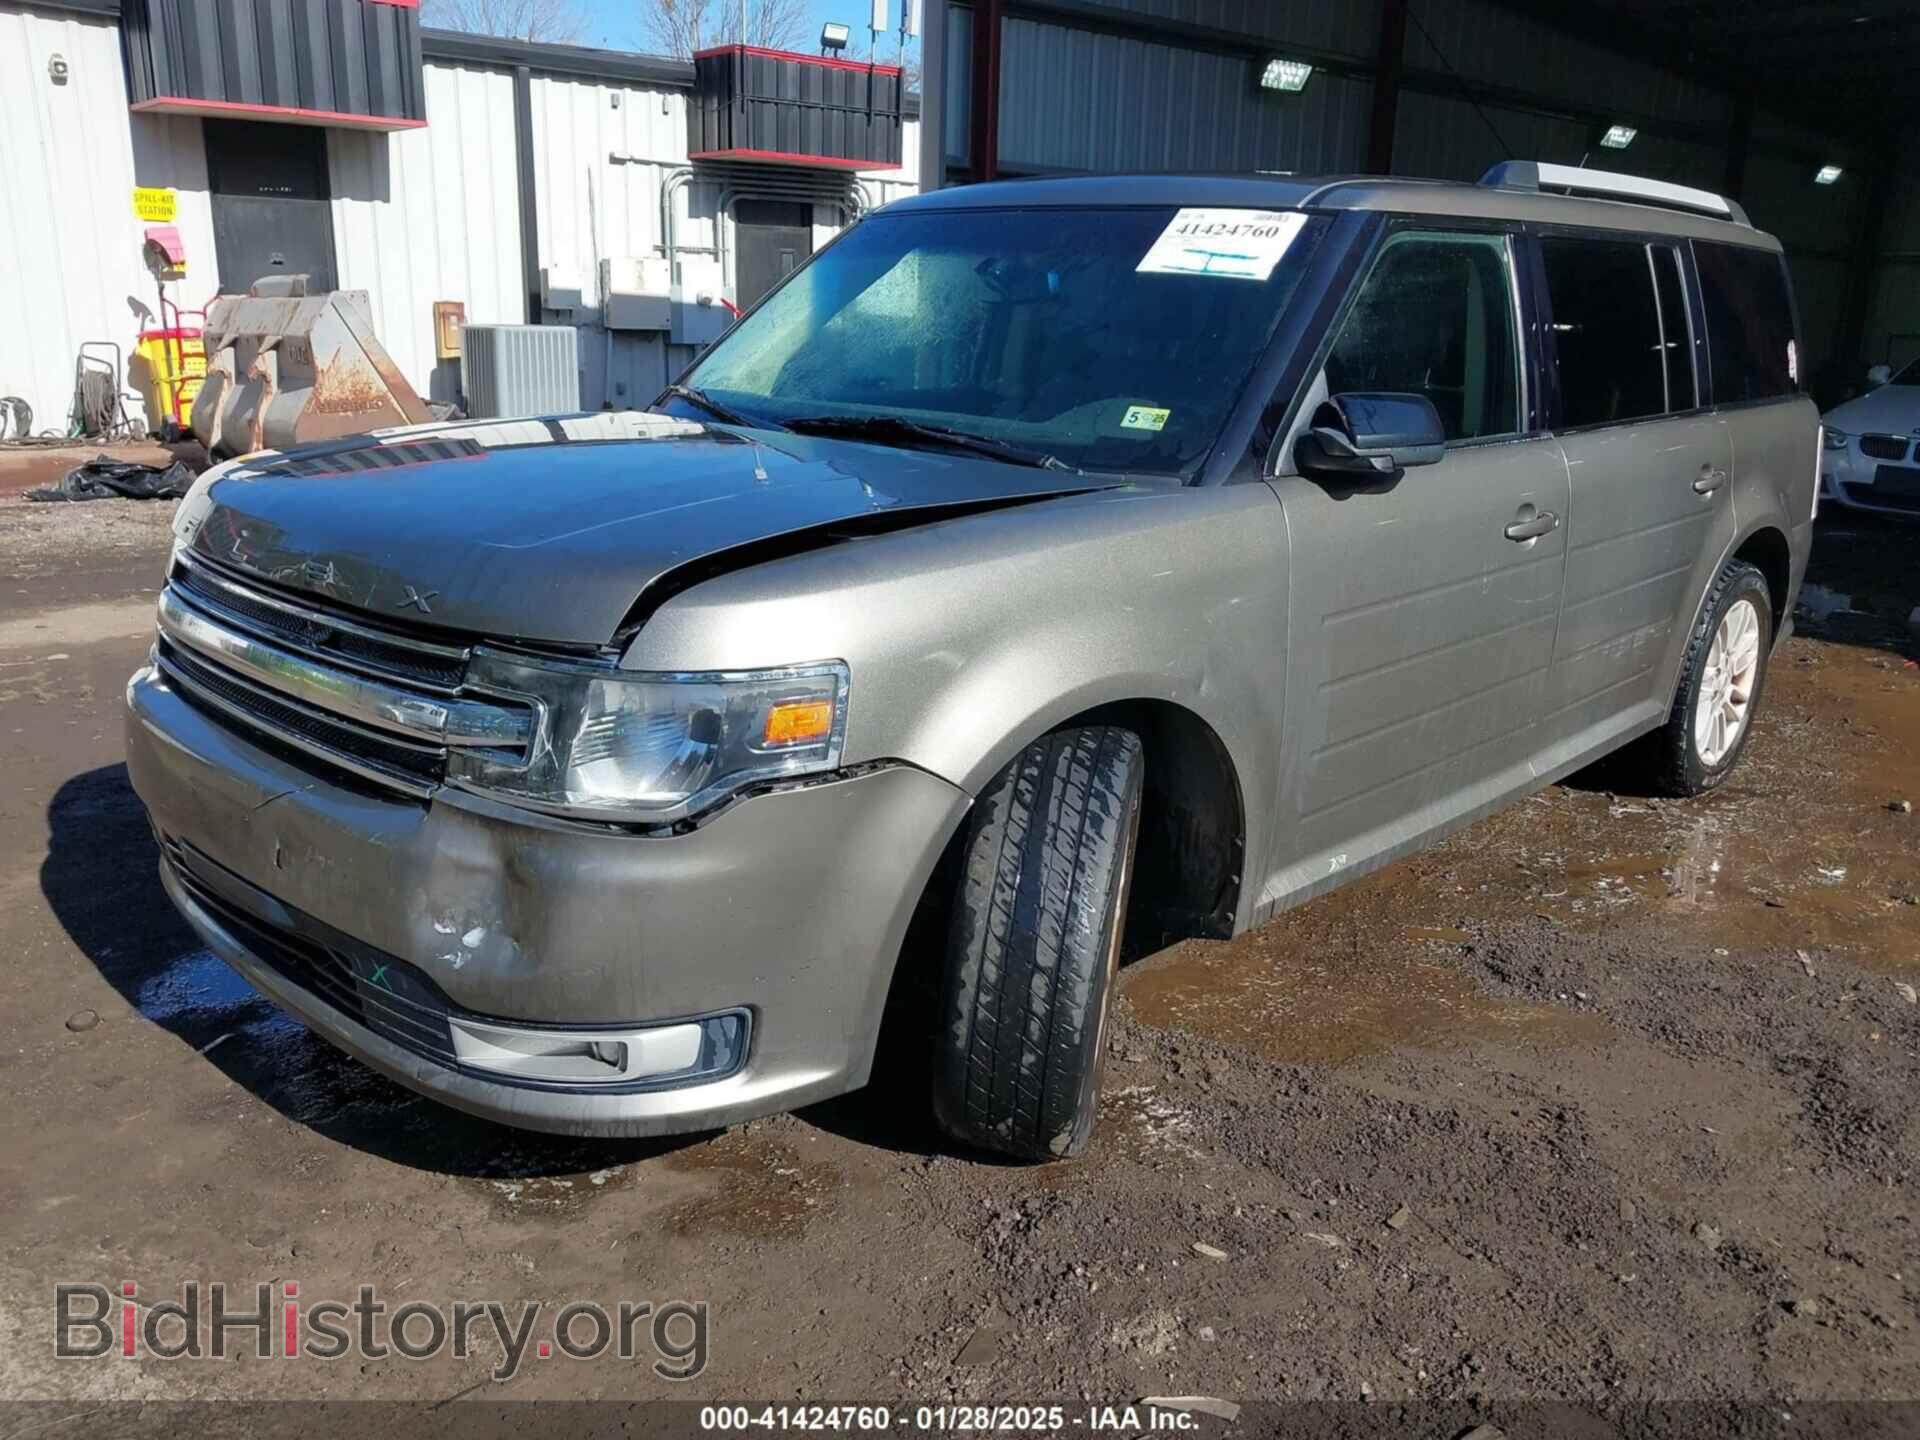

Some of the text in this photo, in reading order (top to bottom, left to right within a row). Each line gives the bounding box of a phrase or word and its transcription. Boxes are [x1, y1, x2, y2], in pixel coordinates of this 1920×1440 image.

[137, 205, 173, 216] STATION
[1176, 223, 1280, 238] 41424760
[1128, 411, 1140, 423] 5
